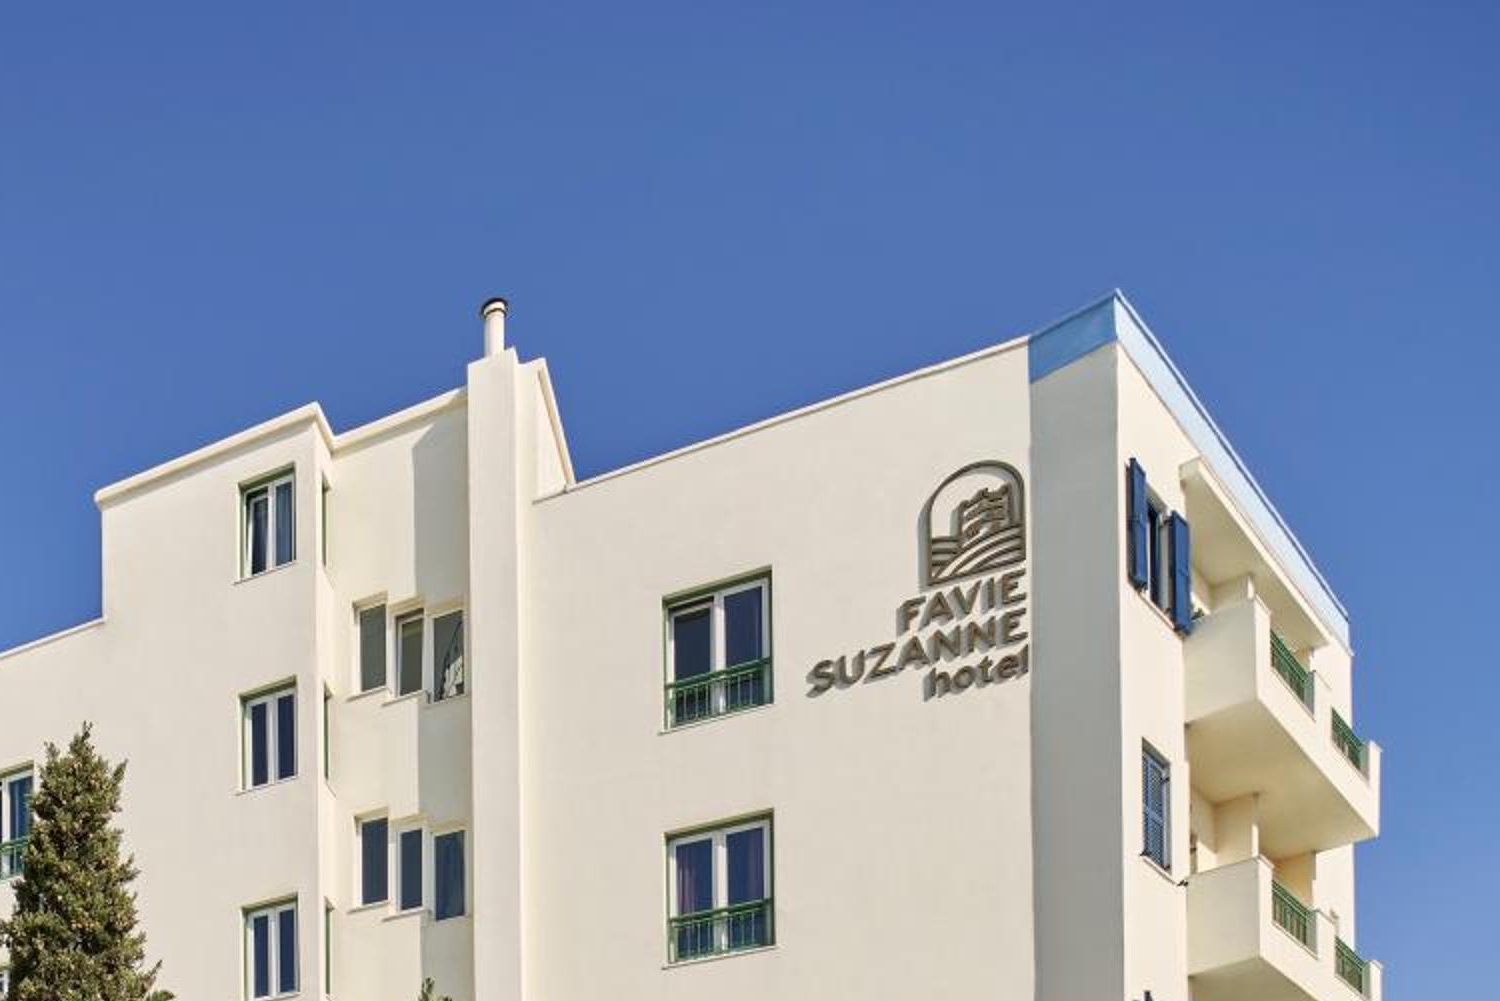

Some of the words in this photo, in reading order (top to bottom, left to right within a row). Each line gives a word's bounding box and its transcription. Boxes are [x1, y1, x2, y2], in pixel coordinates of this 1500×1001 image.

[898, 567, 1027, 636] FAVIE
[806, 607, 1029, 697] SUZANNE
[924, 643, 1030, 701] hotel
